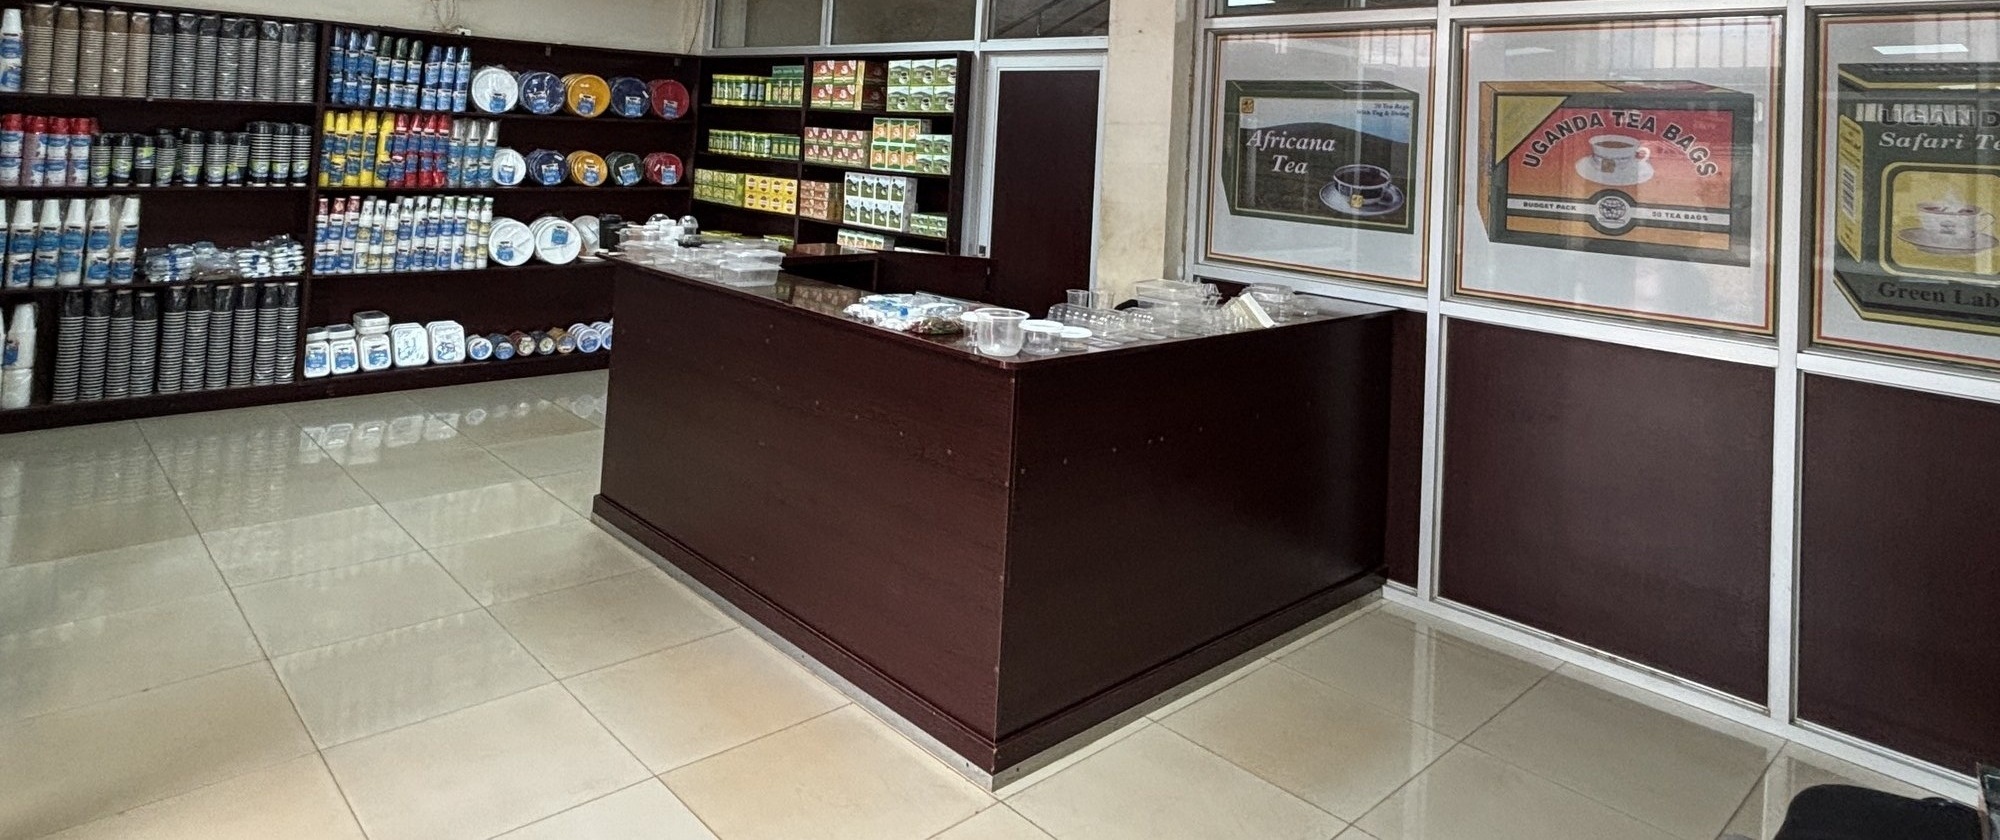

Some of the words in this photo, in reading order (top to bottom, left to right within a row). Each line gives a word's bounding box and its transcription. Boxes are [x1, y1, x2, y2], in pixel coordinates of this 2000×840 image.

[1246, 129, 1336, 152] Africana
[1522, 112, 1605, 169] UGANDA
[1611, 110, 1657, 134] TEA
[1661, 122, 1717, 177] BAGS
[1878, 131, 1965, 151] Safari
[1271, 154, 1309, 175] Tea
[1523, 201, 1554, 210] BUDGET
[1555, 204, 1577, 212] PACK
[1664, 211, 1681, 220] TEA
[1683, 214, 1709, 222] BAGS
[1878, 282, 1945, 303] Green
